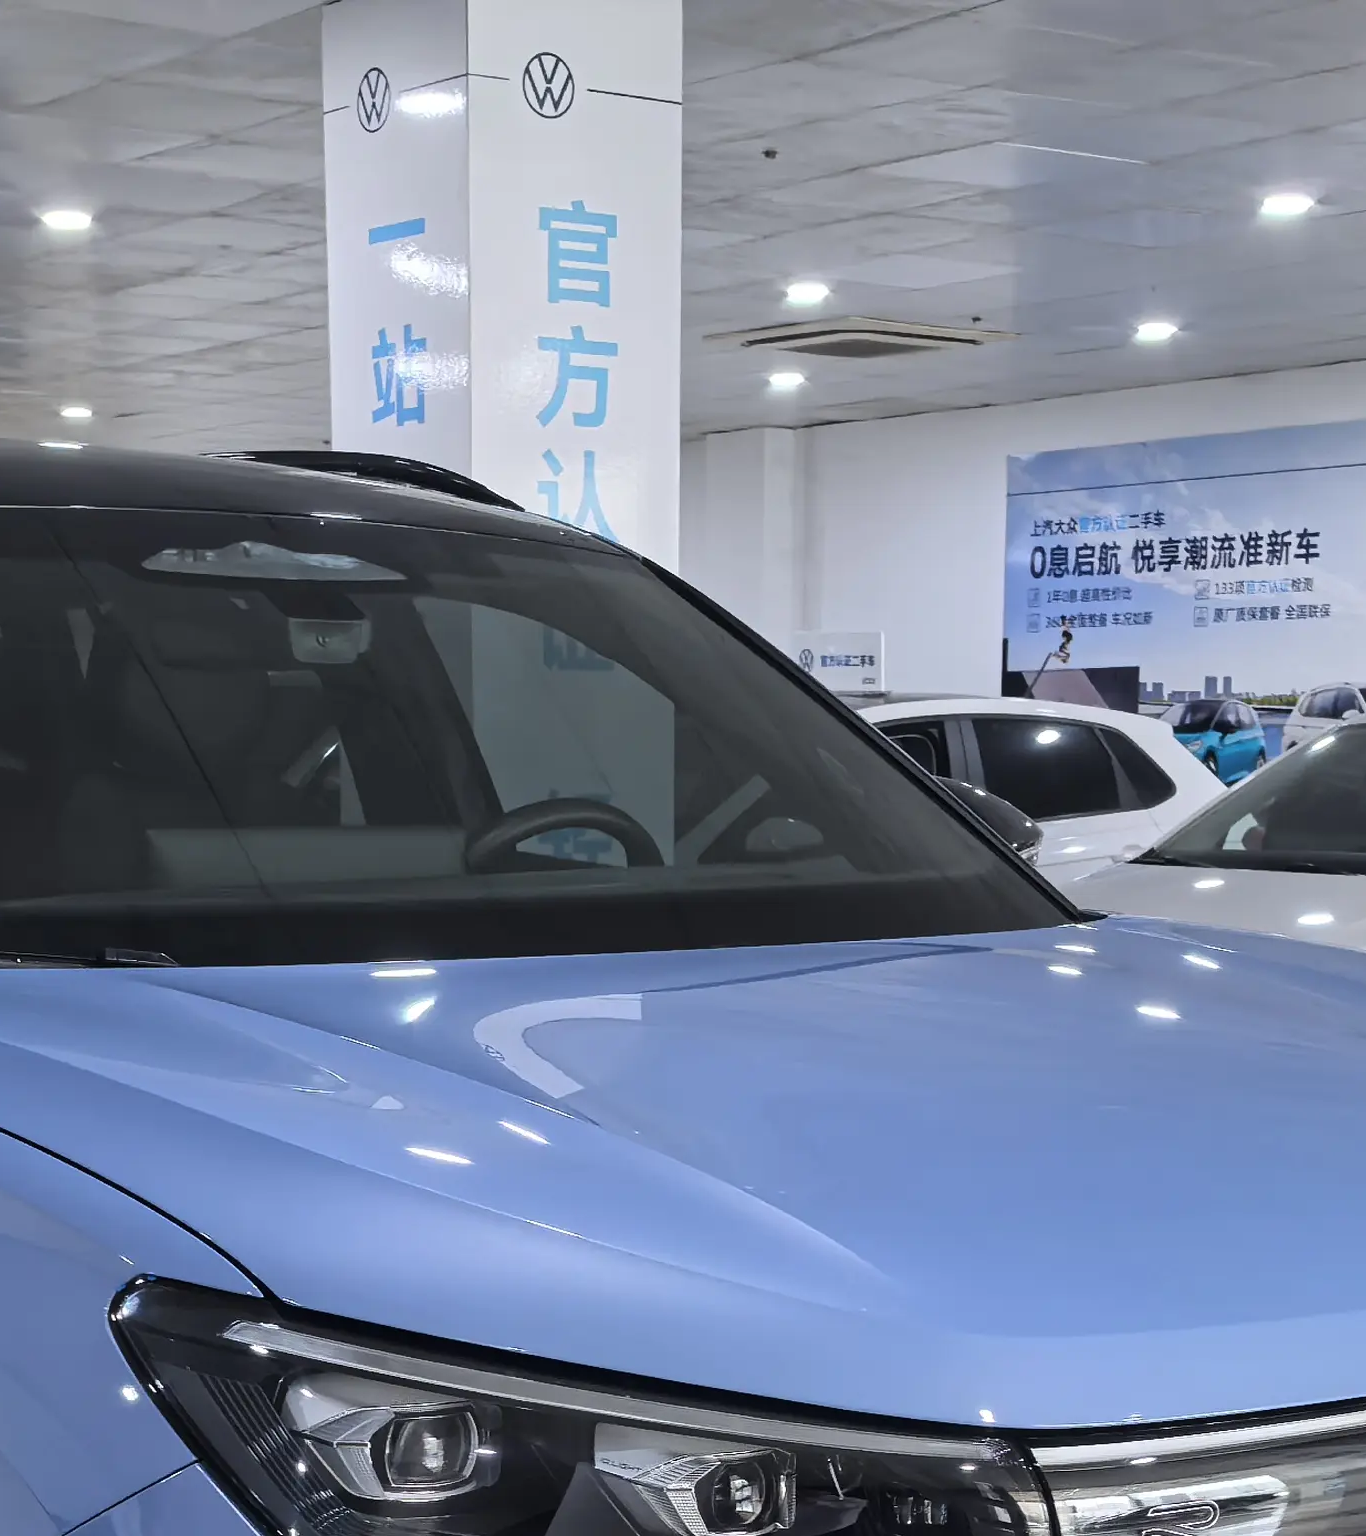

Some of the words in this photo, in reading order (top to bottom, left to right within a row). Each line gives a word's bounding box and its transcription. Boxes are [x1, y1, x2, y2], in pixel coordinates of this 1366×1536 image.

[357, 67, 390, 133] VW
[522, 52, 574, 118] VW
[368, 217, 426, 427] 一站
[1030, 541, 1121, 579] 0息启航
[1131, 527, 1320, 574] 悦享潮流准新车
